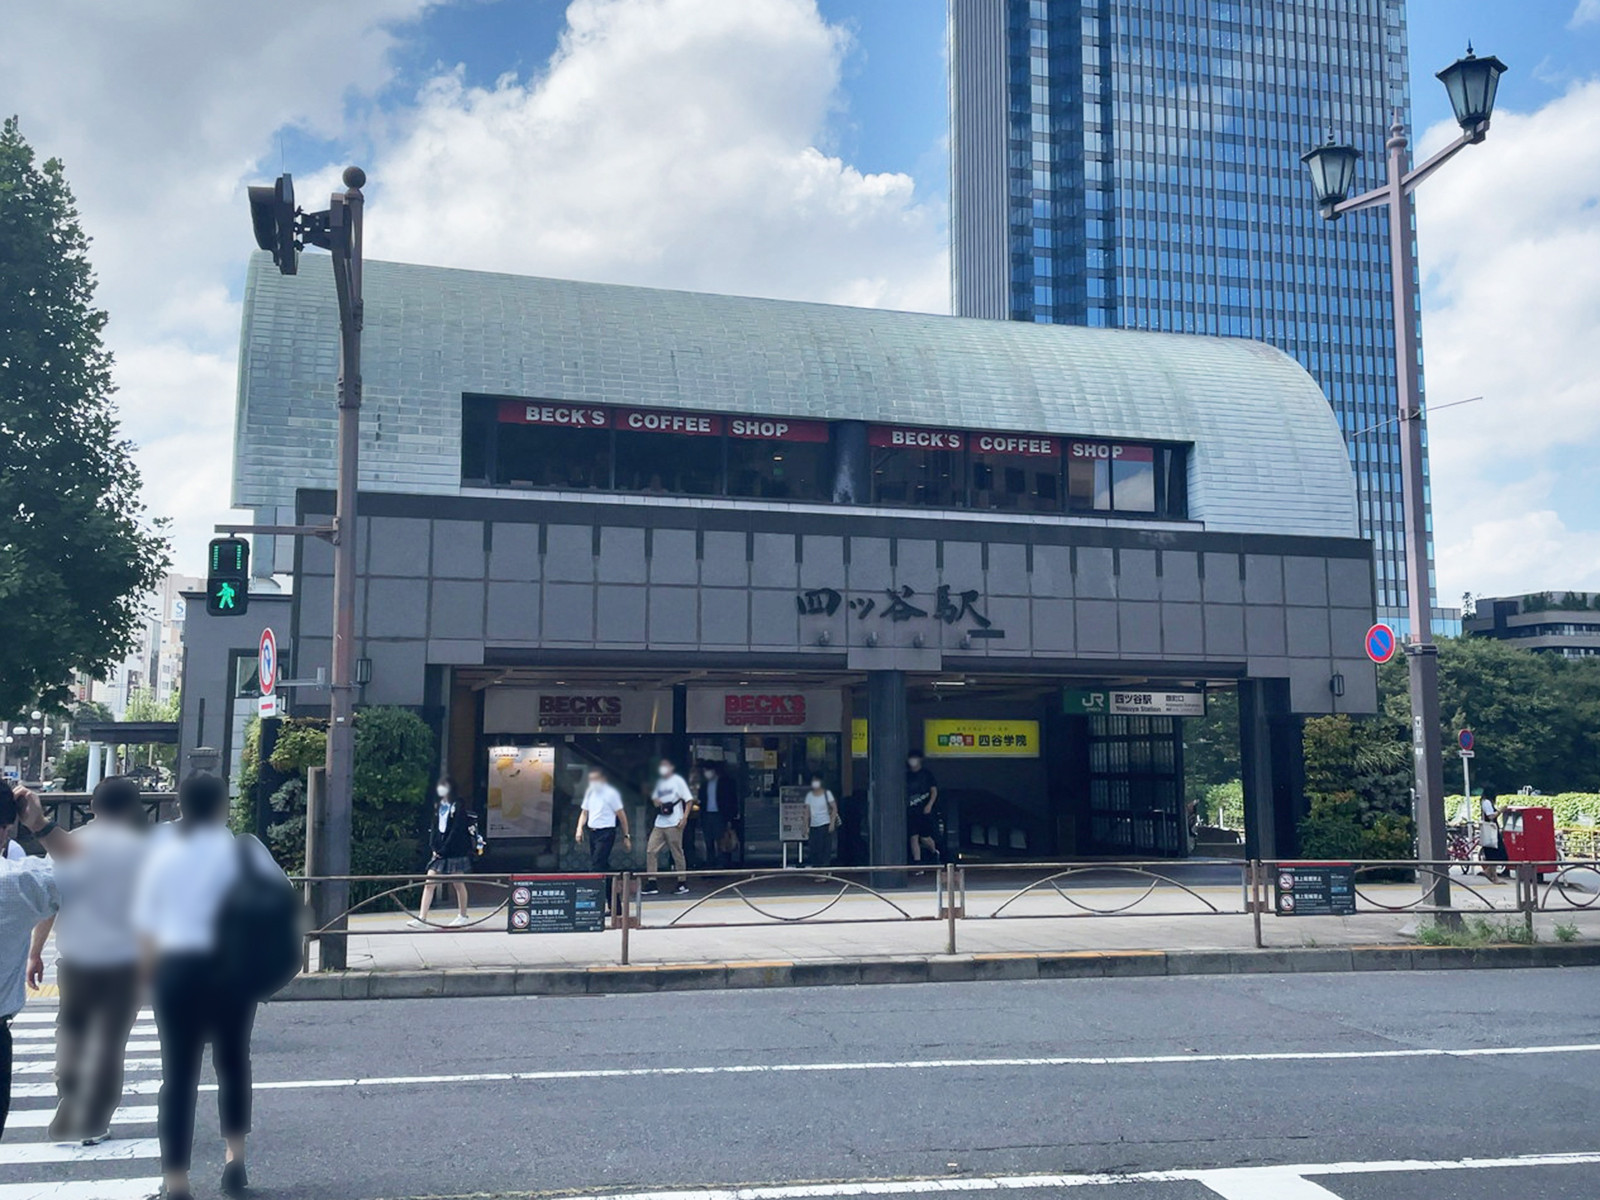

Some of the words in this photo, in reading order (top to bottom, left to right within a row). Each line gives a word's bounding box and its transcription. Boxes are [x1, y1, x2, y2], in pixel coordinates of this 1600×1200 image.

[525, 406, 605, 426] BECK'S
[628, 413, 711, 433] COFFEE
[732, 420, 789, 438] SHOP
[892, 430, 960, 449] BECK'S
[979, 436, 1052, 454] COFFEE
[1072, 443, 1123, 460] SHOP
[539, 695, 622, 713] BECK'S
[725, 694, 806, 713] BECK'S
[1081, 693, 1105, 707] JR
[1114, 694, 1153, 705] 四ツ谷駅
[539, 716, 586, 727] COFFEE
[588, 716, 621, 727] SHOP
[978, 734, 1028, 747] 四谷学院
